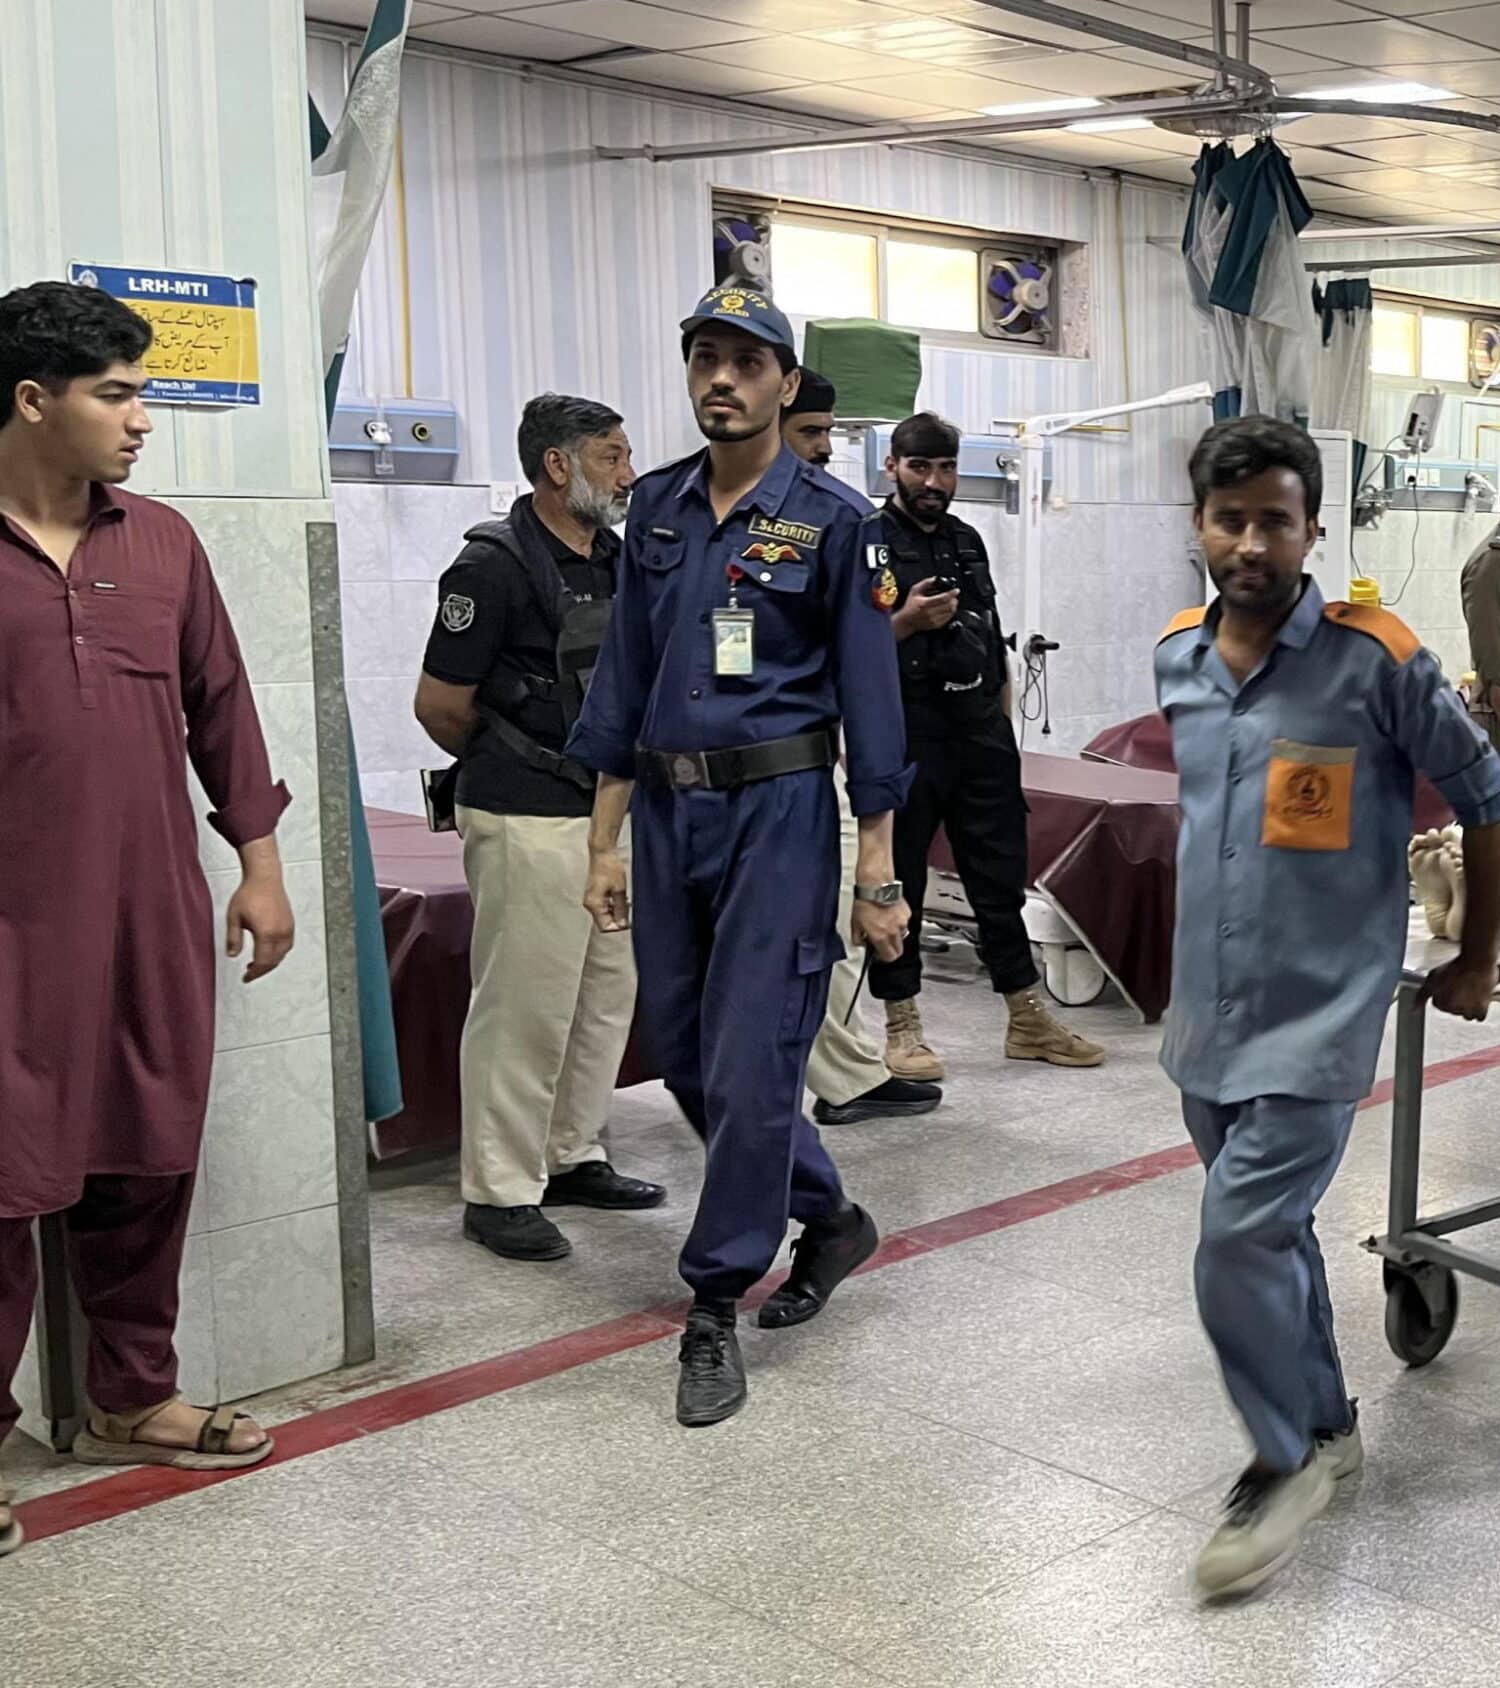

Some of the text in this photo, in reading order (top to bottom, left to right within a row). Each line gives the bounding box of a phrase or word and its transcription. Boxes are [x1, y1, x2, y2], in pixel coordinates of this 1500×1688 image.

[128, 277, 209, 297] LRH-MTI
[160, 330, 193, 350] مریض
[208, 336, 231, 356] آپ
[759, 519, 817, 543] SECURITY
